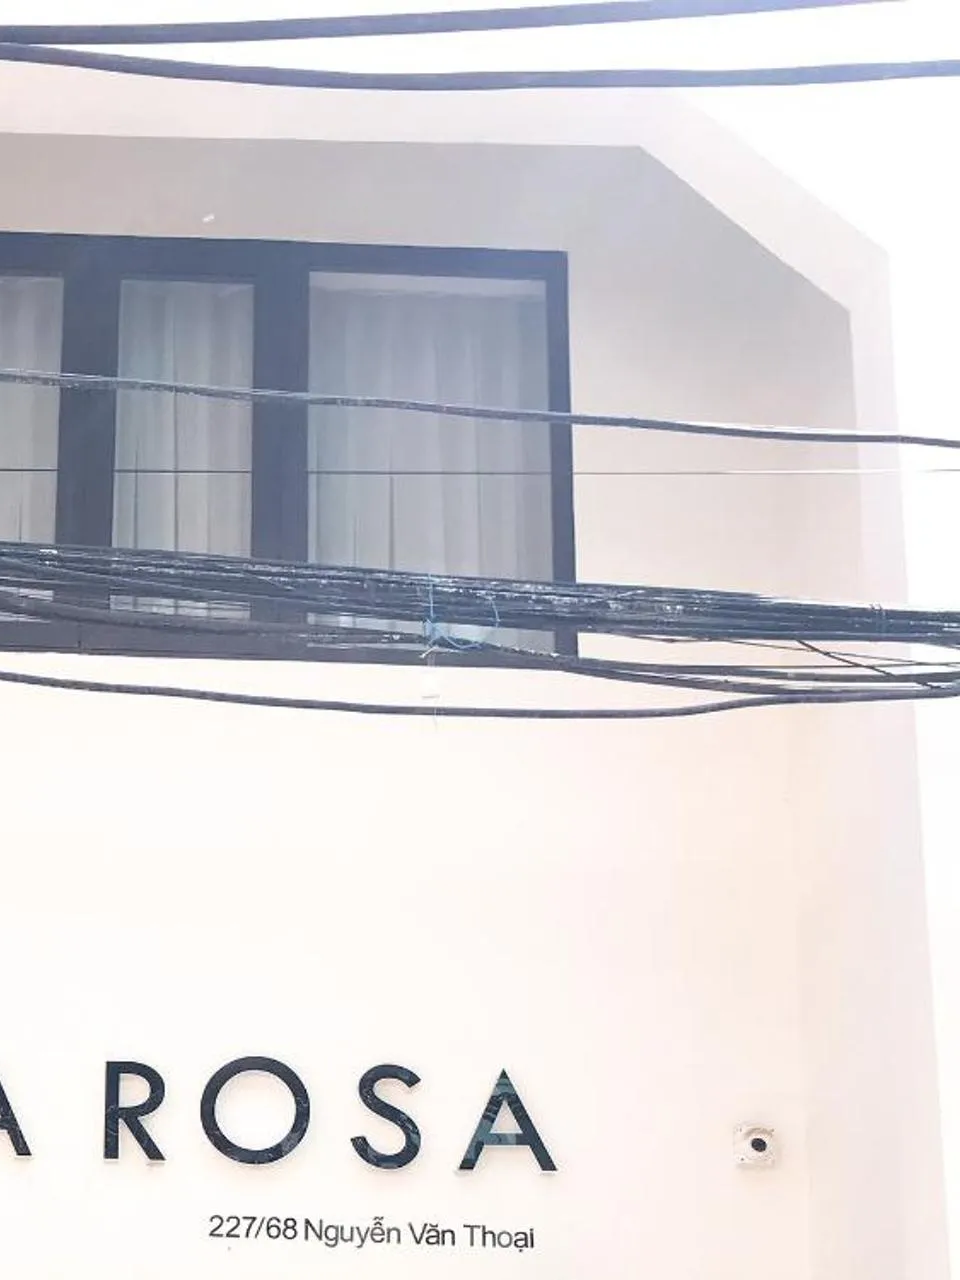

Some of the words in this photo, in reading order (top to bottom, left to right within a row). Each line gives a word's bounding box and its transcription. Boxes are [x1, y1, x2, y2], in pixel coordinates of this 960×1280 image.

[103, 1056, 558, 1173] ROSA
[208, 1214, 298, 1240] 227/68
[304, 1216, 401, 1249] Nguyễn
[408, 1222, 456, 1247] Văn
[462, 1224, 535, 1253] Thoại
